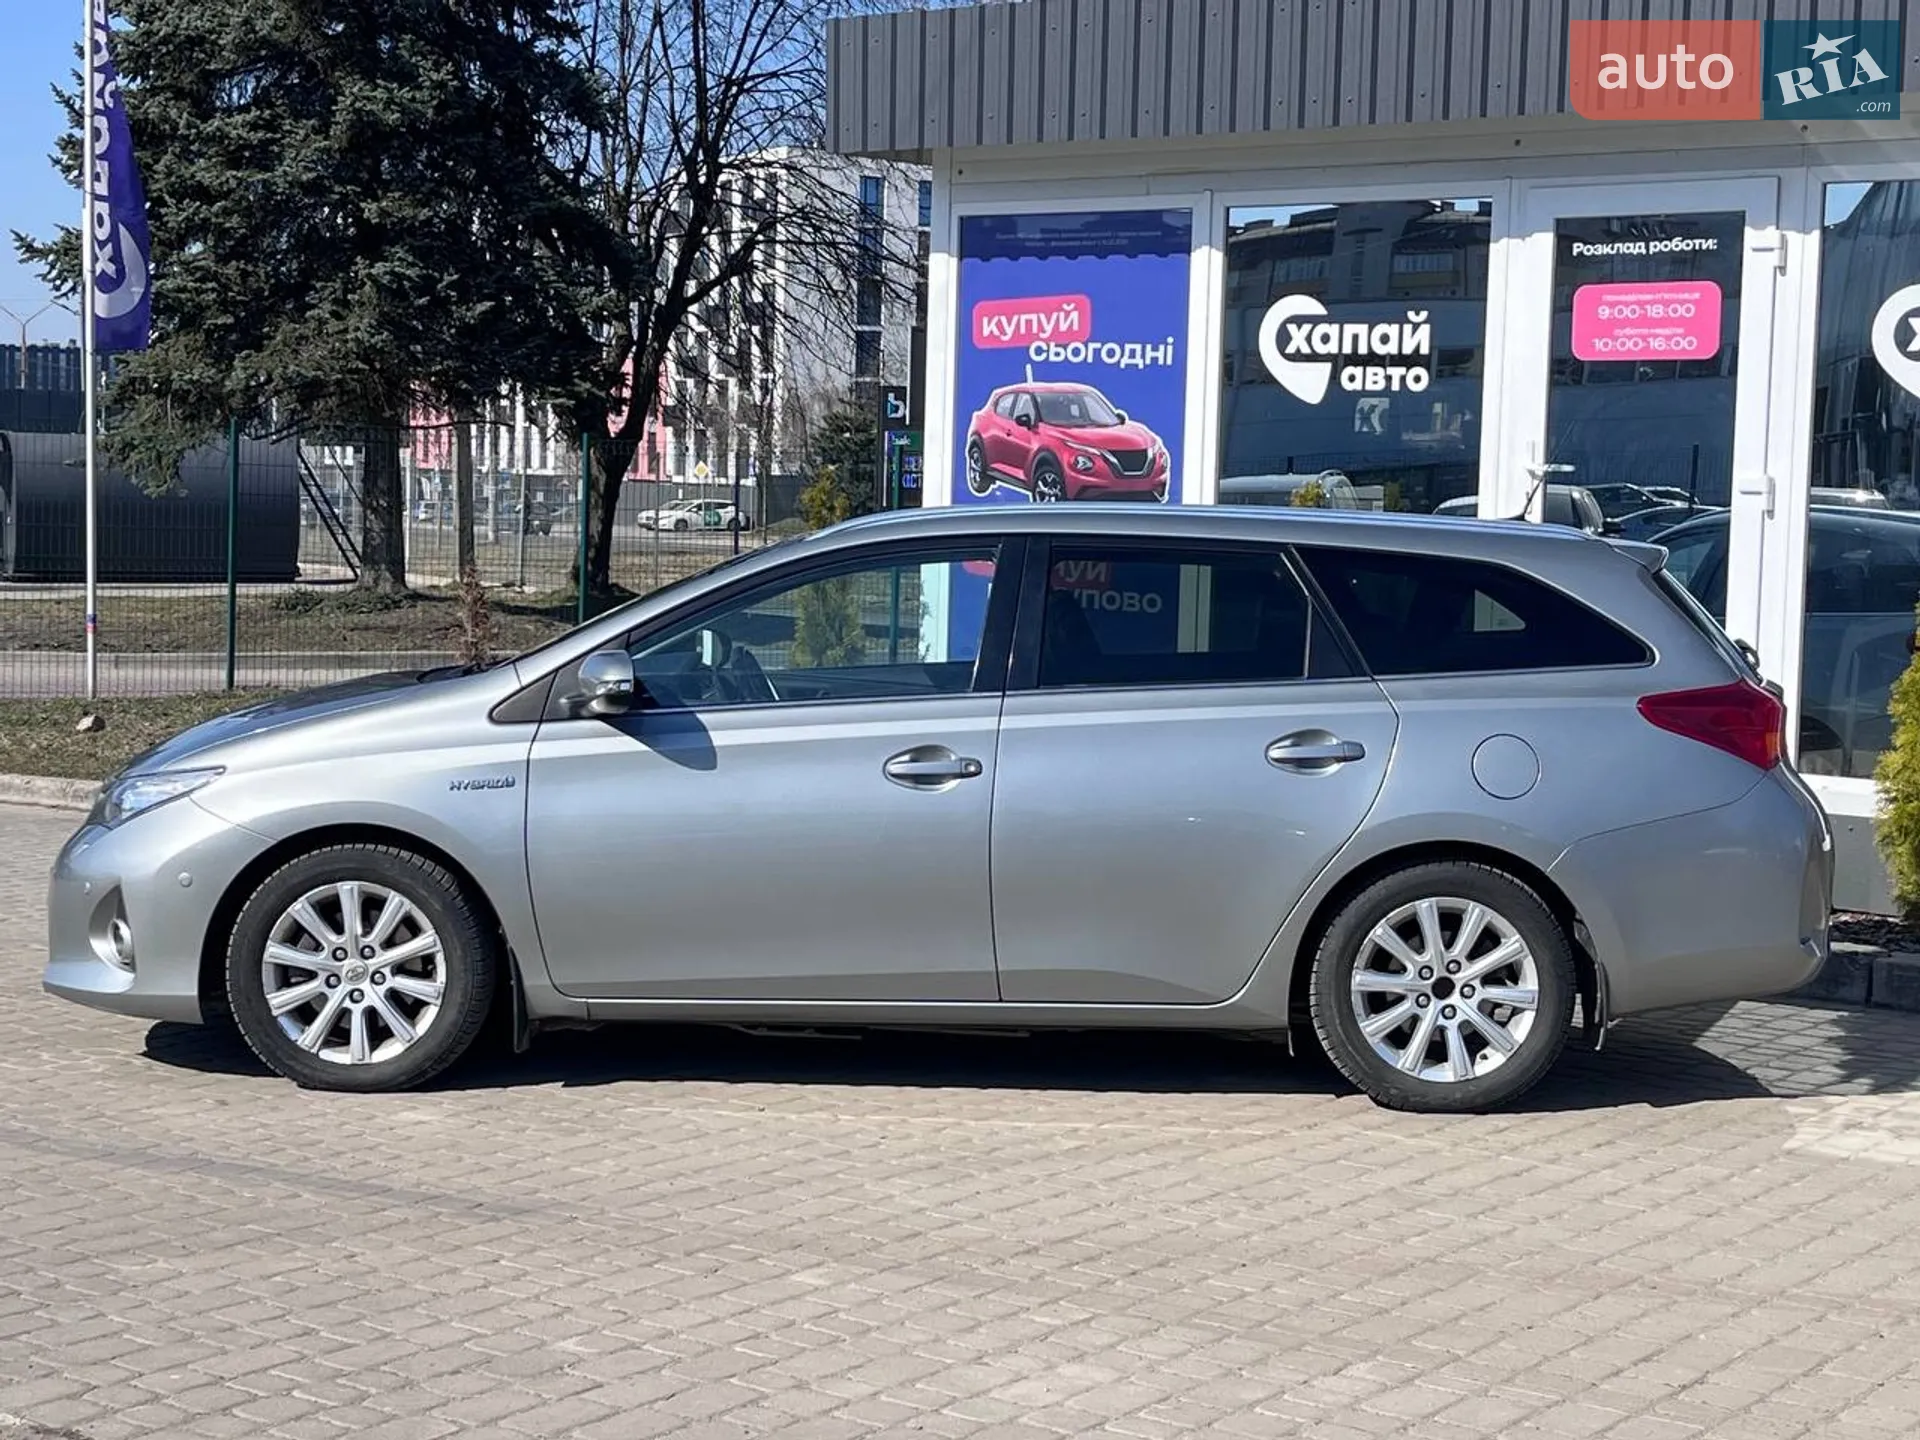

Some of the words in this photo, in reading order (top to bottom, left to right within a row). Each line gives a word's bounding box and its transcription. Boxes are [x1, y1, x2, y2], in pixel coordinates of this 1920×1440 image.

[1572, 242, 1646, 257] Розклад
[1649, 237, 1718, 254] роботи:
[1597, 303, 1696, 320] 9:00-18:00
[982, 303, 1080, 341] купуй
[1029, 336, 1174, 369] сьогодні
[1592, 336, 1698, 352] 10:00-16:00
[1340, 366, 1430, 392] авто
[449, 778, 506, 791] HYBRID
